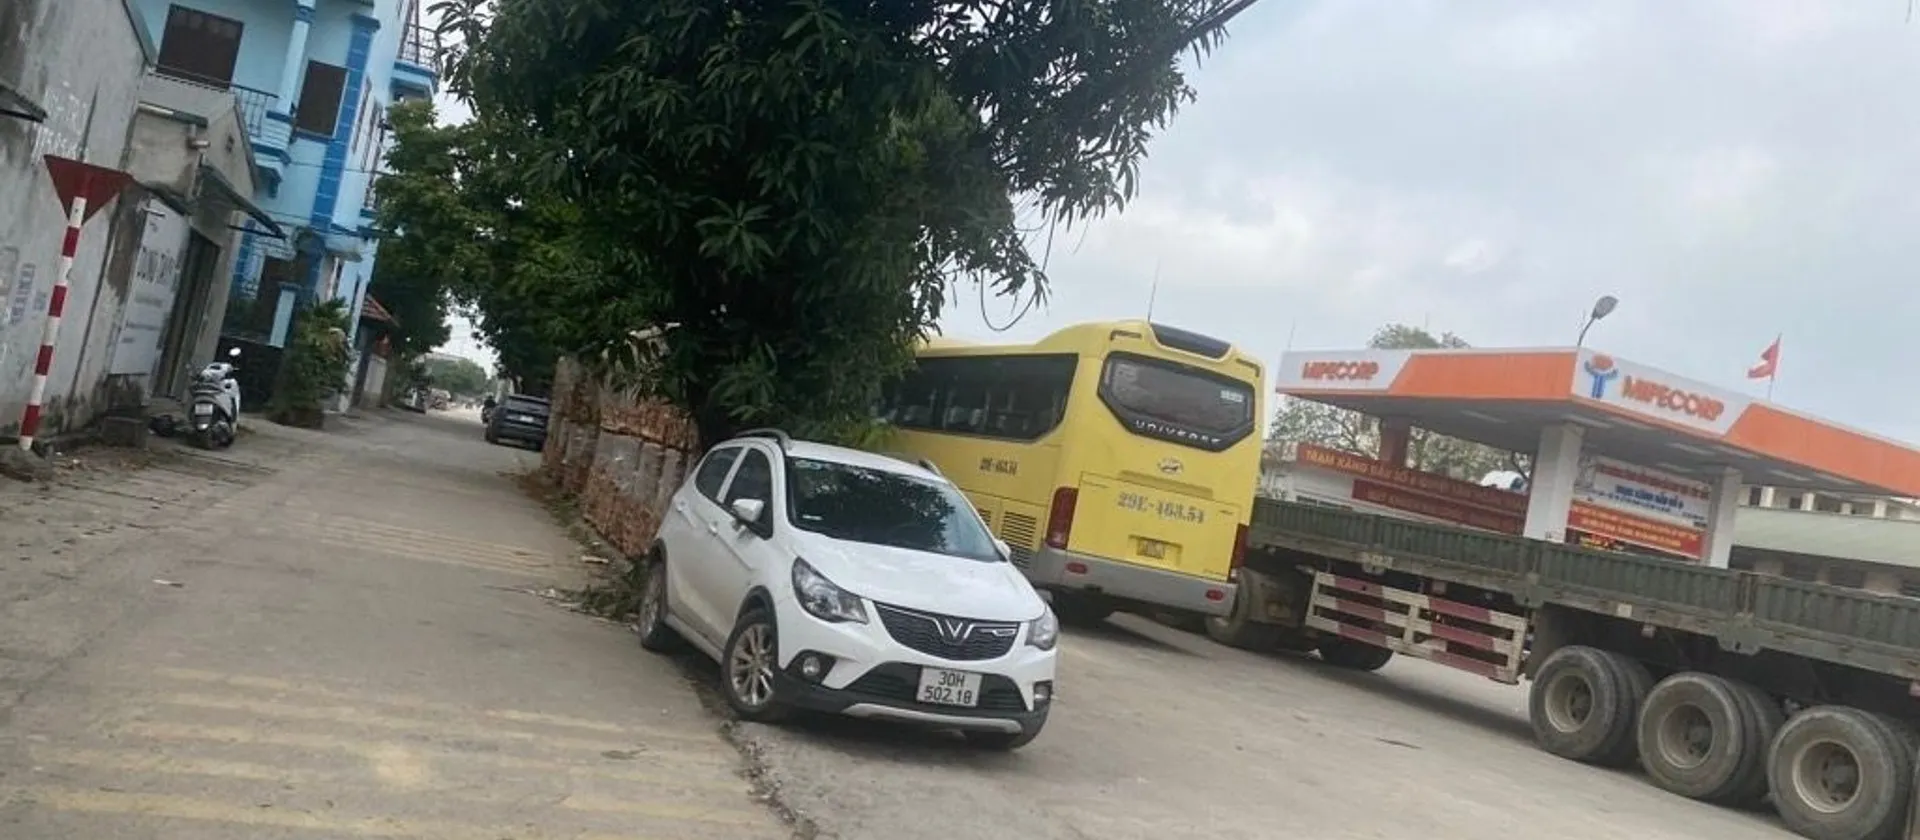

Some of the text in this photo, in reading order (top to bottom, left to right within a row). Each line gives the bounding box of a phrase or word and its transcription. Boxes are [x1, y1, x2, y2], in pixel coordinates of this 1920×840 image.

[1302, 361, 1379, 381] MIPECORP
[1623, 375, 1724, 421] MIPECORP
[937, 671, 965, 688] 30H
[924, 687, 973, 704] 502.18
